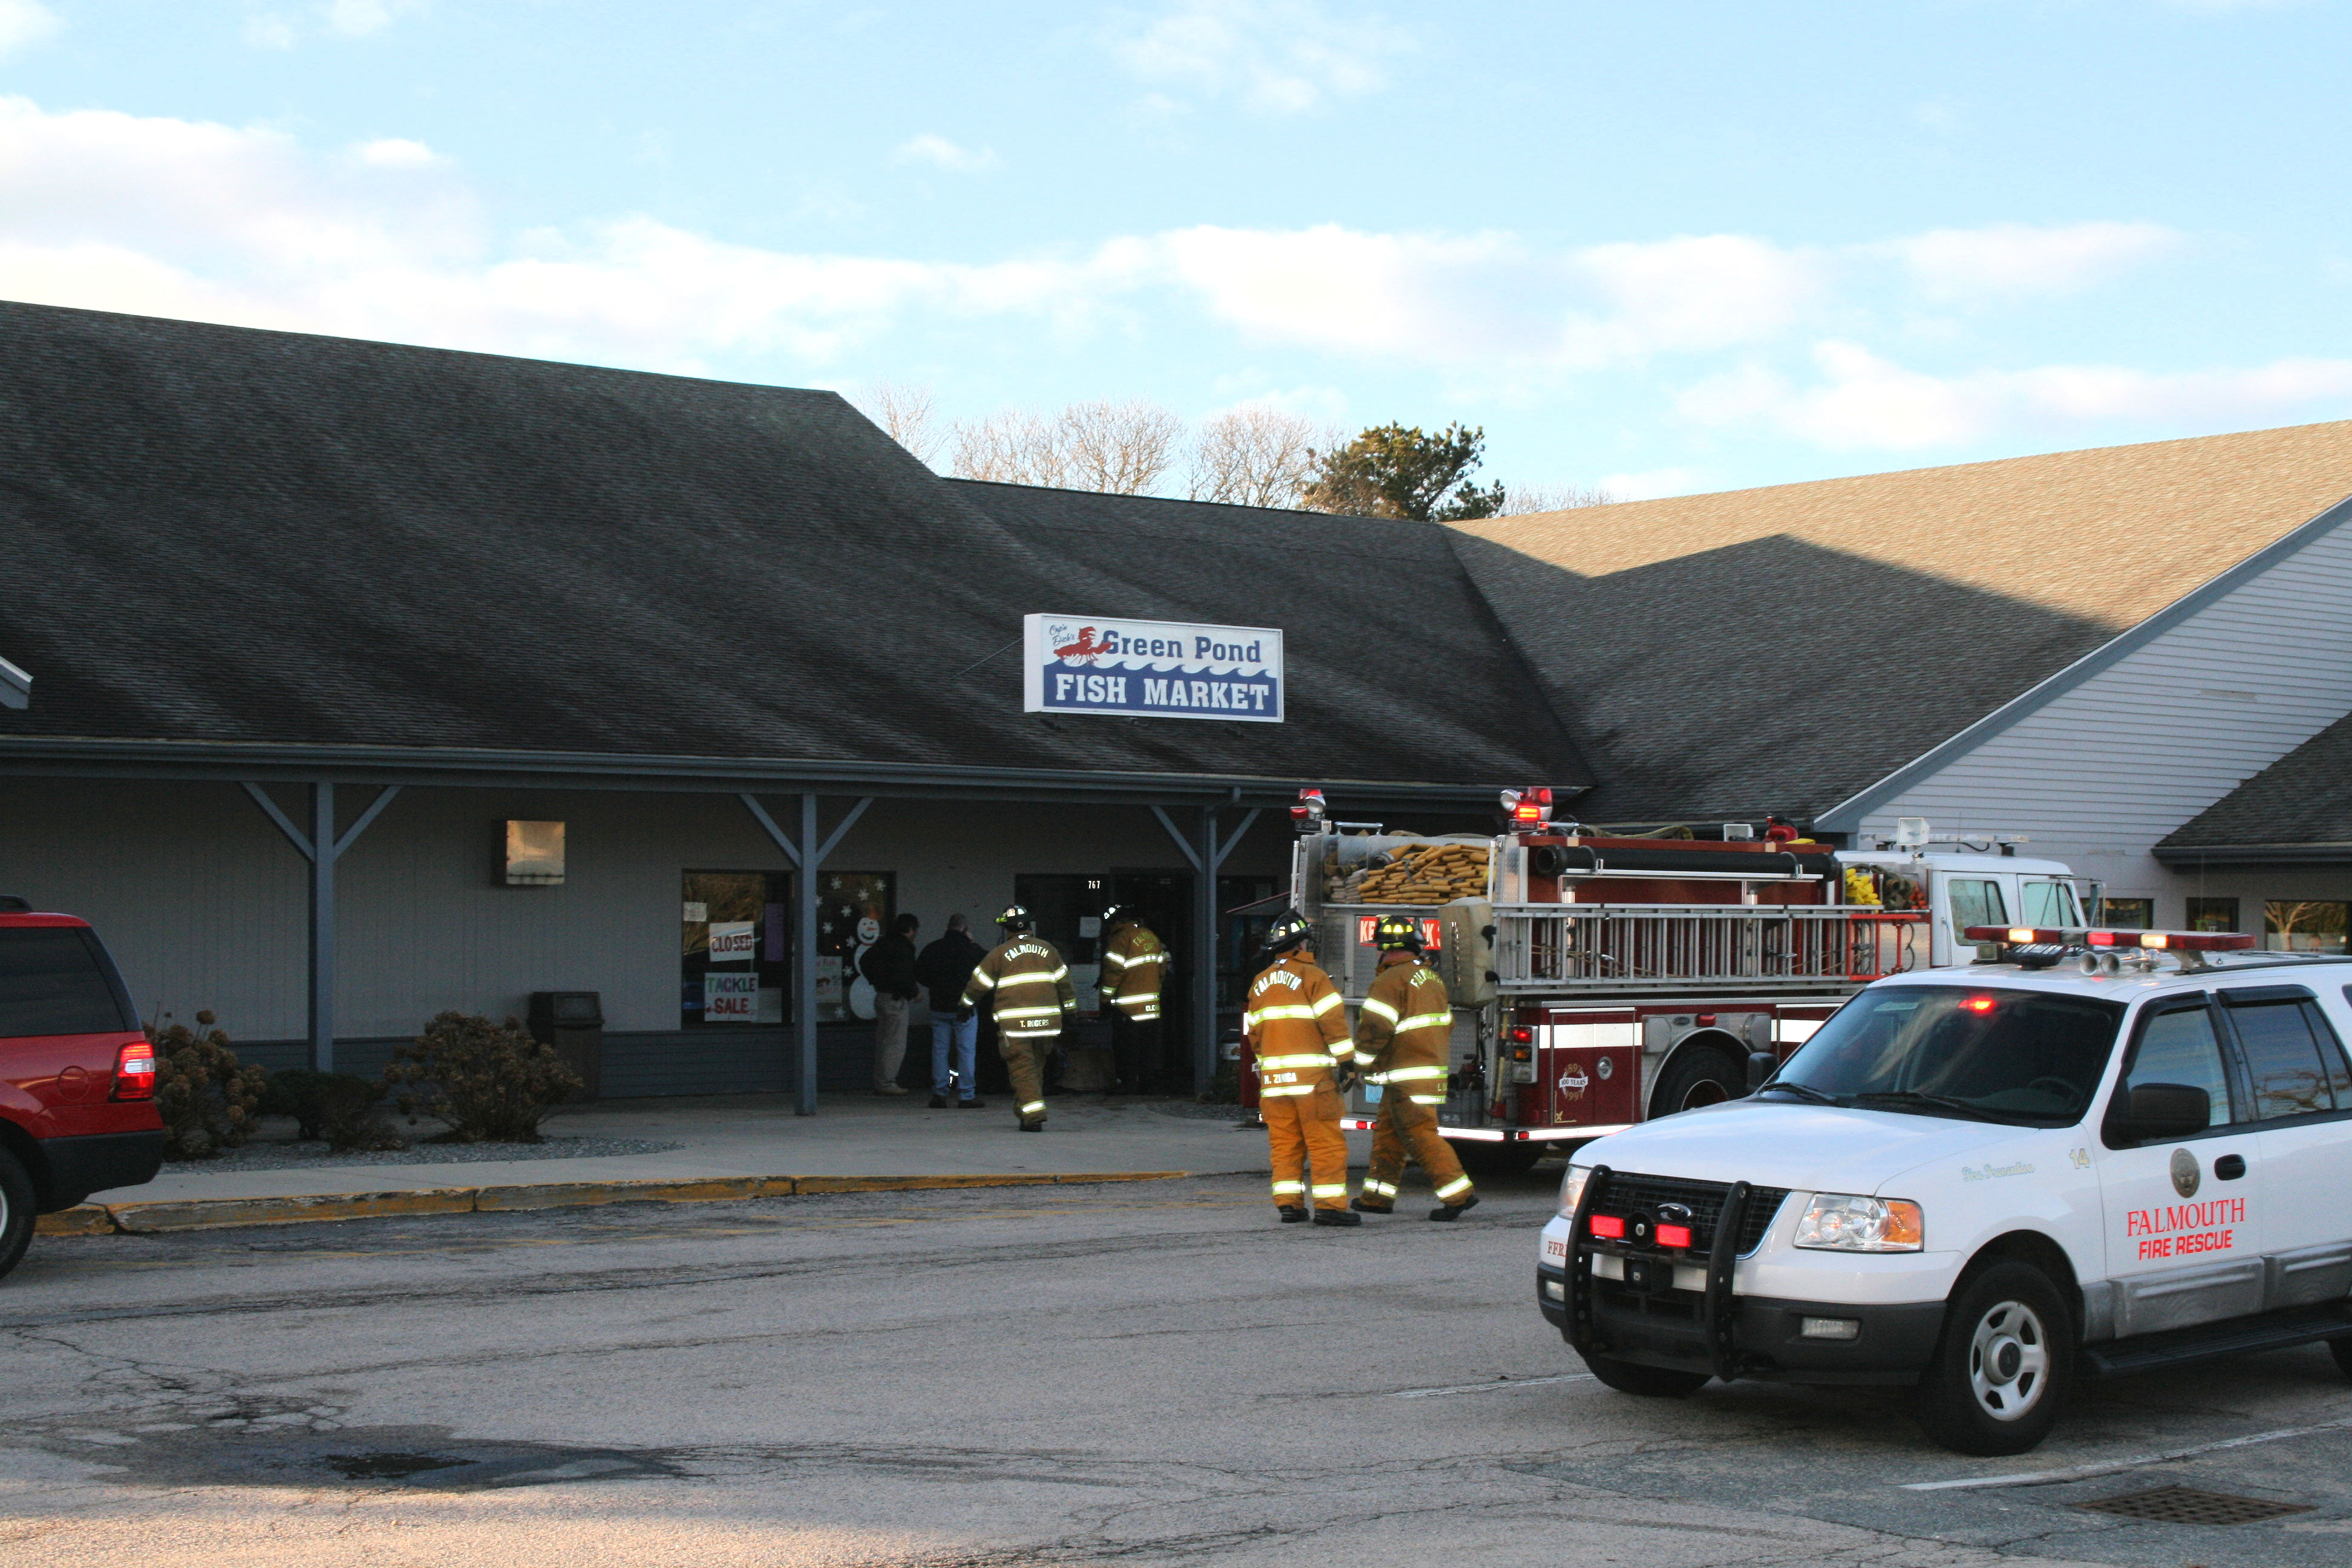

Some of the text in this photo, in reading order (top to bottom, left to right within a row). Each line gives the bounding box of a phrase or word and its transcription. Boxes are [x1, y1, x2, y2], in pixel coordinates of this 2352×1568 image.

[1102, 630, 1262, 663] Green Pond
[1056, 673, 1269, 710] FISH MARKET
[1088, 880, 1101, 889] 767
[1360, 920, 1376, 943] KE
[711, 934, 753, 953] CLOSED
[1004, 943, 1049, 962] FALMOUTH
[706, 977, 756, 994] TACKLE
[1253, 970, 1302, 997] FALMOUTH
[714, 998, 749, 1014] SALE
[1027, 1019, 1049, 1028] ROGERS
[2069, 1148, 2091, 1169] 14
[2127, 1197, 2246, 1237] FALMOUTH
[2138, 1229, 2234, 1261] FIRE RESCUE
